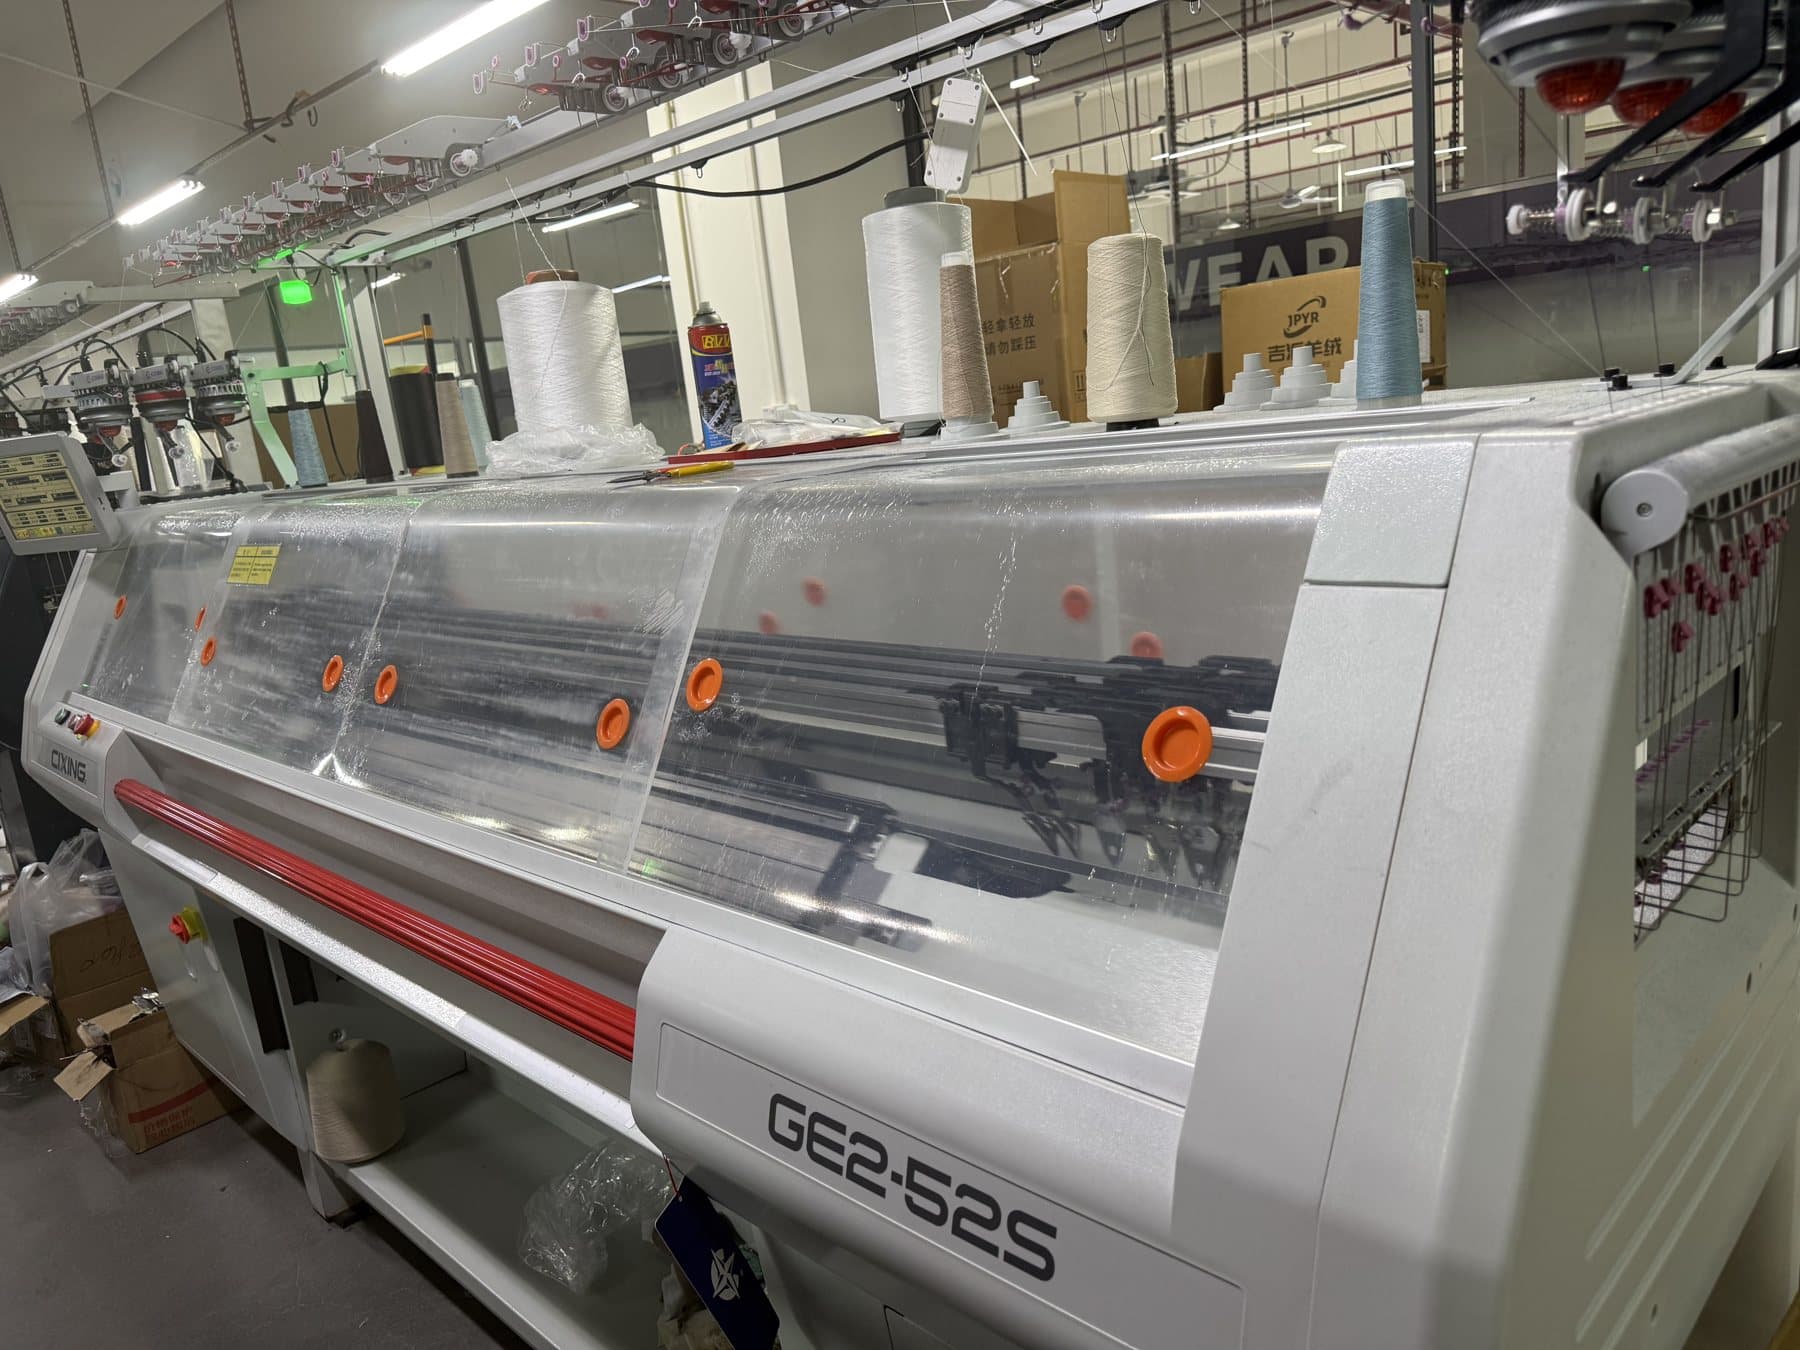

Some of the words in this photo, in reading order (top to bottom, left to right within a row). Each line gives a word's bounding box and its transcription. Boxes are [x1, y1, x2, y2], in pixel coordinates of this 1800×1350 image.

[981, 314, 1036, 335] 轻拿轻放
[1287, 311, 1320, 328] JPYR
[51, 749, 87, 784] CIXING
[768, 1093, 1058, 1282] GE2-52S
